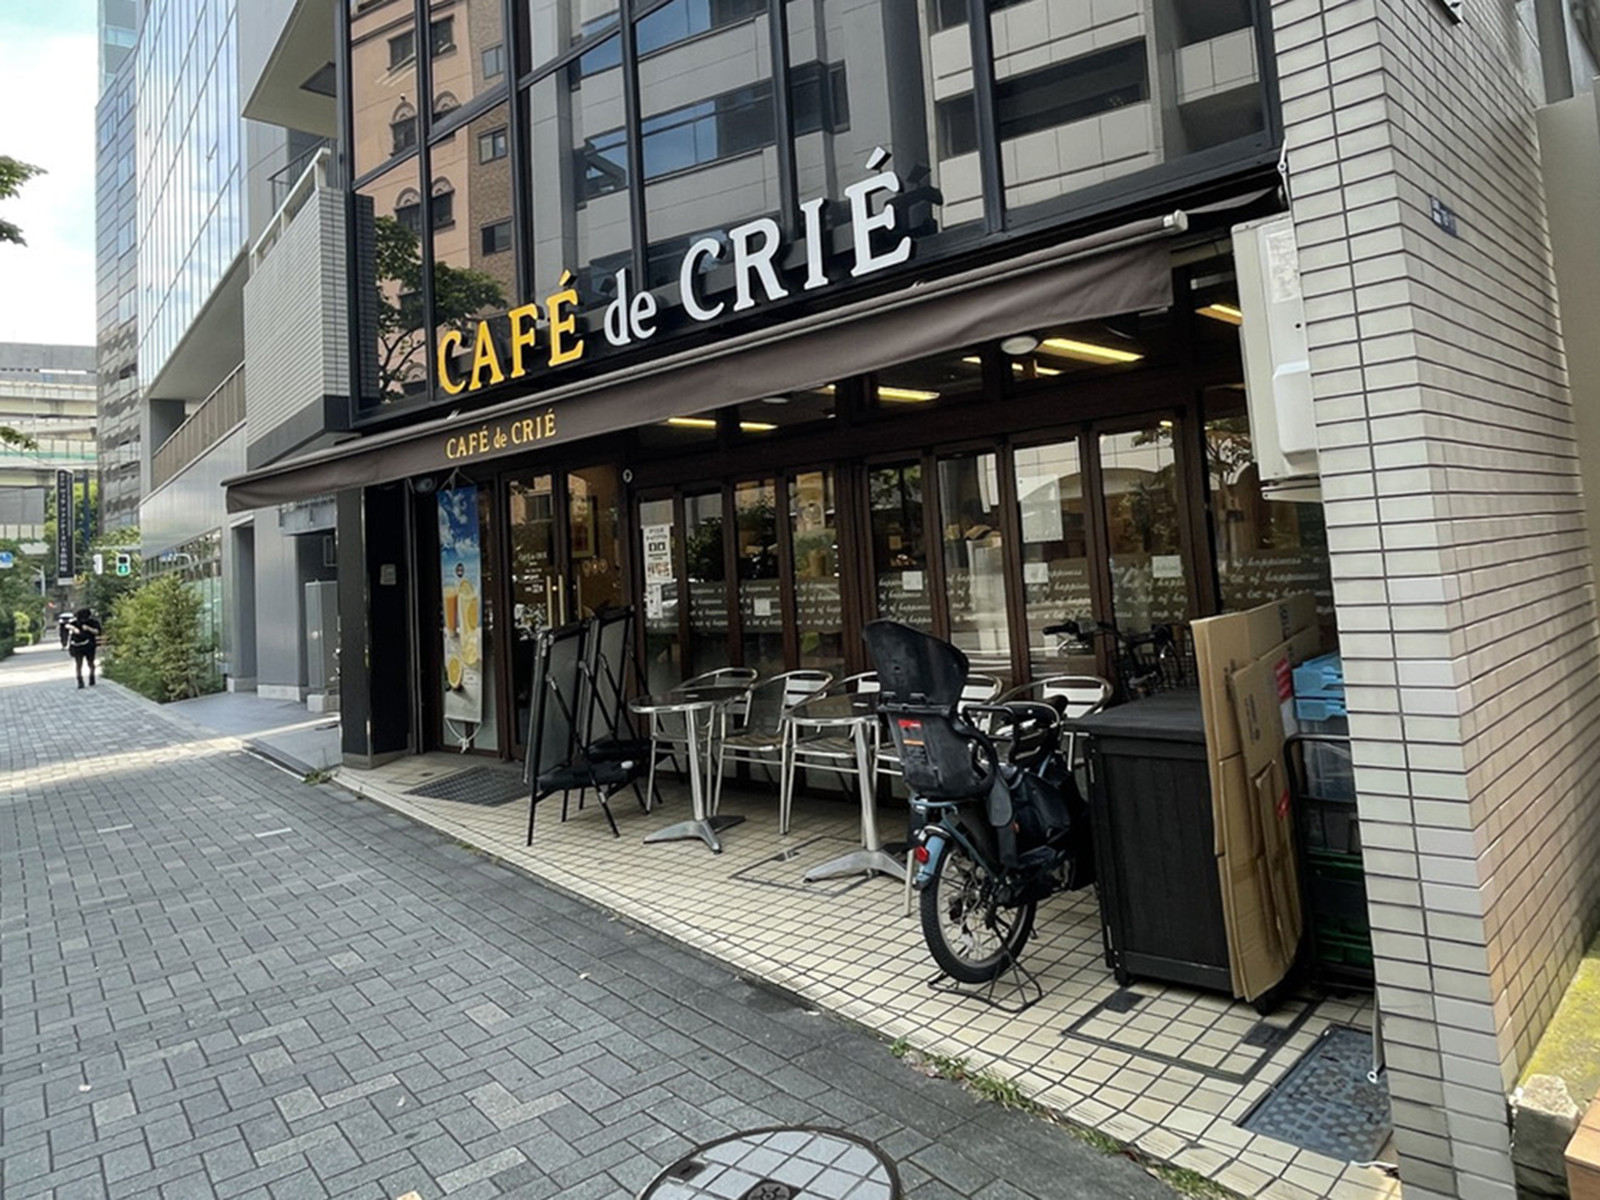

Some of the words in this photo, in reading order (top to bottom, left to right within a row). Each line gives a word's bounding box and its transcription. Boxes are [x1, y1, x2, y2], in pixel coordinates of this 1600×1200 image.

[438, 270, 585, 395] CAFÉ
[603, 269, 657, 347] de
[680, 147, 912, 322] CRIÉ
[446, 426, 490, 460] CAFÉ
[493, 426, 507, 449] de
[511, 409, 557, 445] CRIÉ
